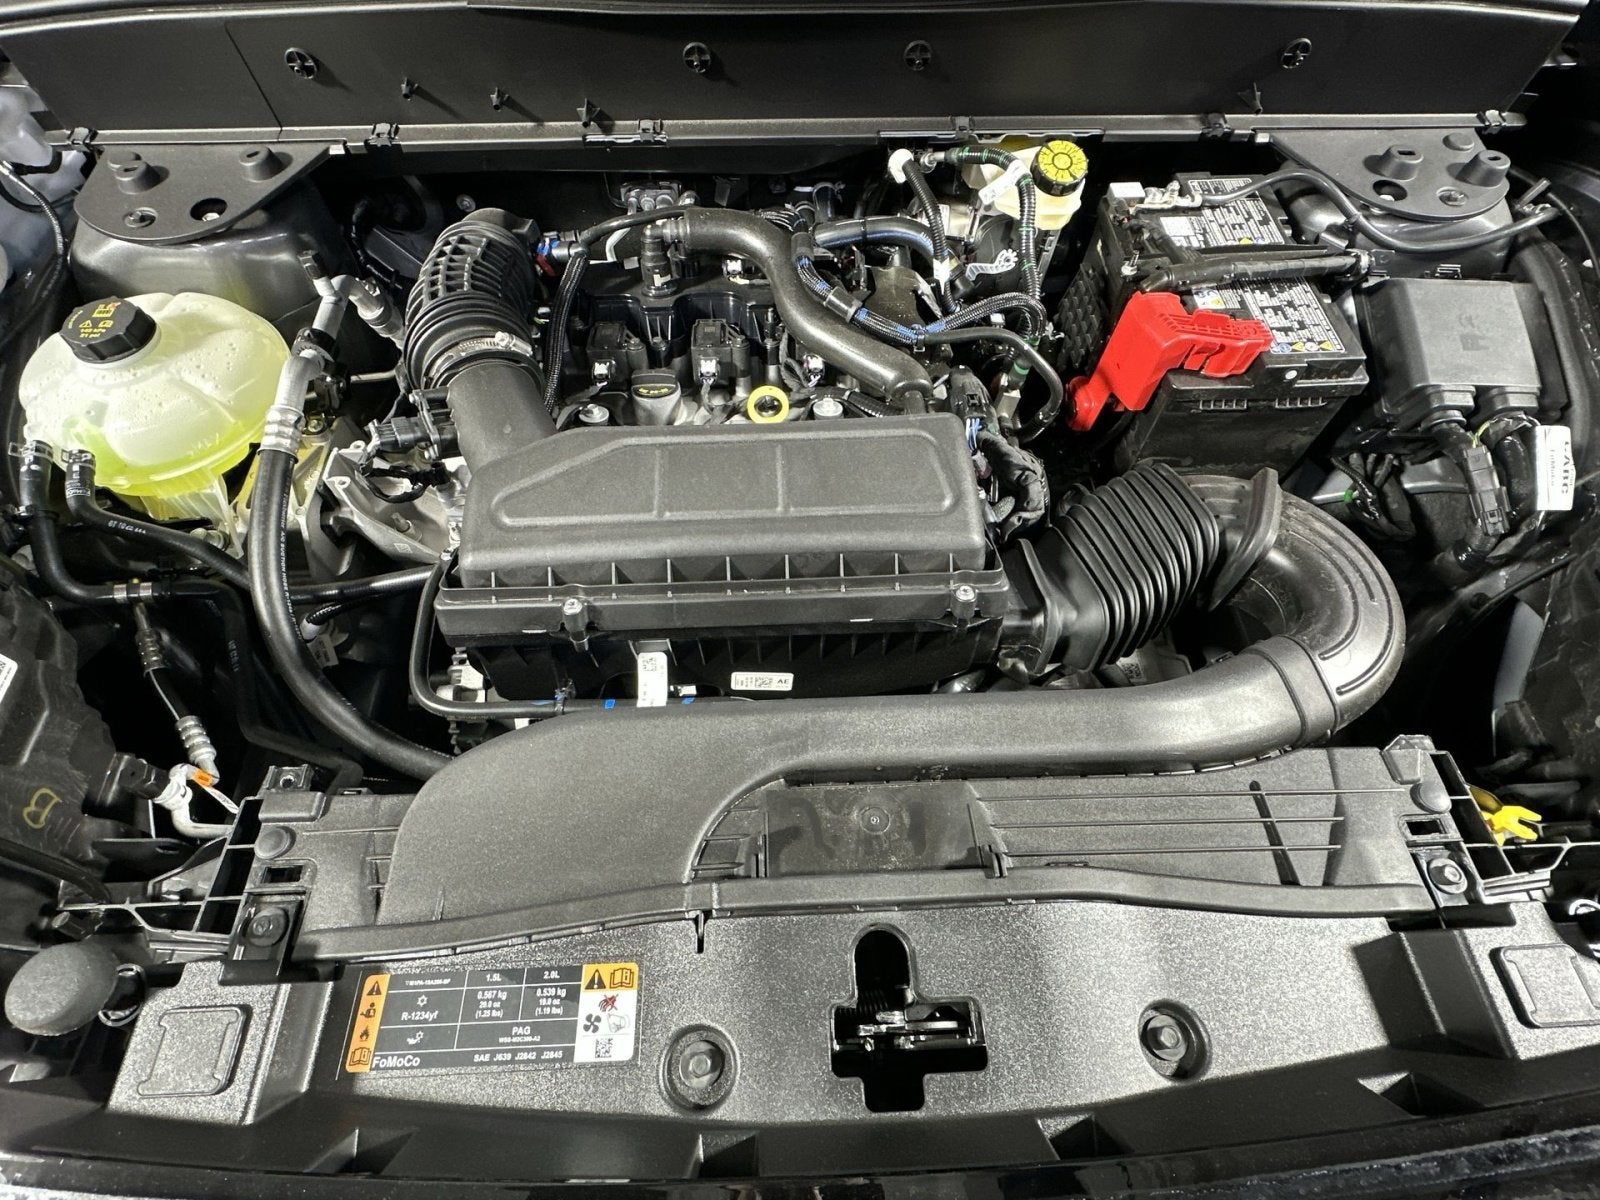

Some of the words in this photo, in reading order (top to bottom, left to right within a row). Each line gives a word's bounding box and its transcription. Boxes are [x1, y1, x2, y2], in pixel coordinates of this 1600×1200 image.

[486, 971, 502, 982] 1.5L
[543, 969, 560, 980] 2.0L
[497, 990, 507, 1002] kg
[555, 987, 567, 998] kg
[401, 1011, 438, 1022] R-1234yf
[512, 1026, 531, 1036] PAG
[473, 1053, 490, 1062] SAE
[493, 1053, 511, 1062] J639
[515, 1051, 537, 1061] J2842
[541, 1050, 563, 1059] J2845
[372, 1056, 420, 1069] FoMoCo
